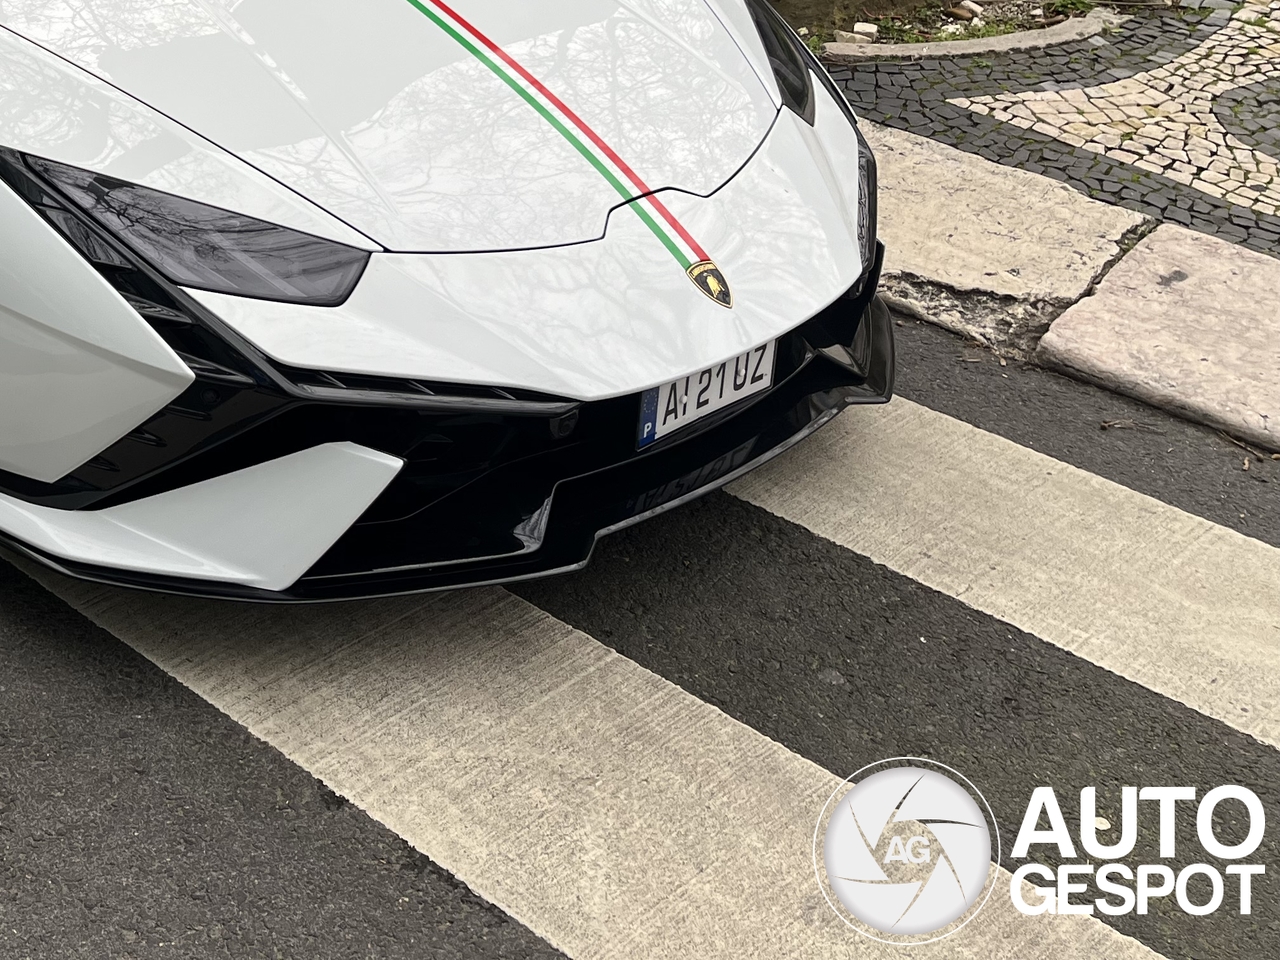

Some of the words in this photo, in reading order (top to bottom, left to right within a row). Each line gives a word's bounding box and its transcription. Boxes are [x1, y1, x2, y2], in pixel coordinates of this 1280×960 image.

[696, 362, 727, 410] 21
[733, 343, 768, 392] UZ
[643, 422, 652, 438] P
